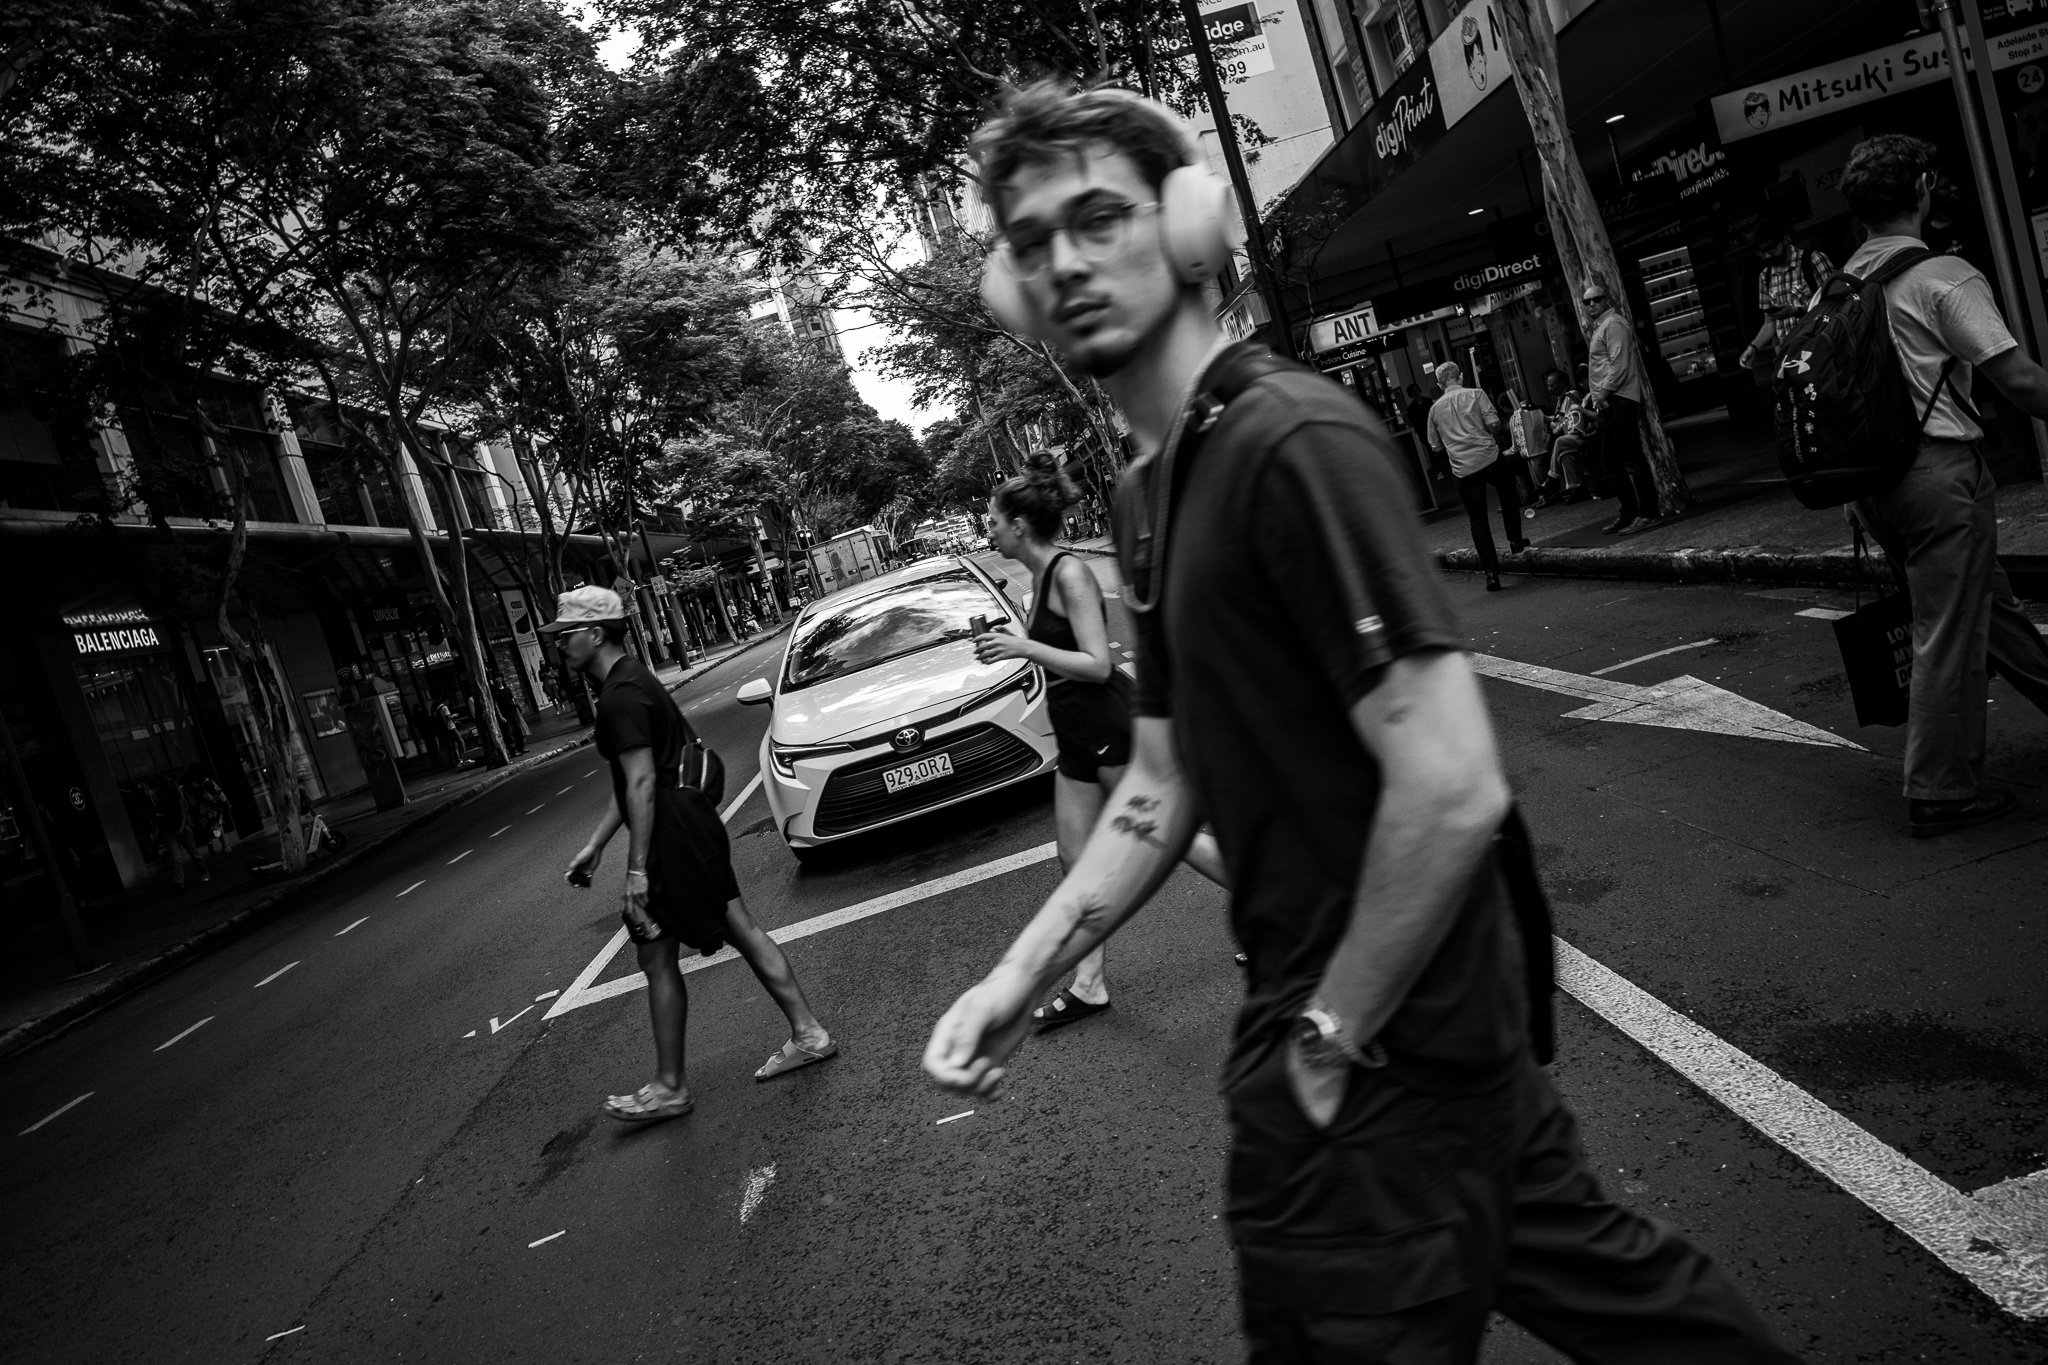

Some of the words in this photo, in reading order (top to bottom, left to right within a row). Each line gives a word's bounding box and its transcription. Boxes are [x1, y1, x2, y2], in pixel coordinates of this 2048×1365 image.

[1997, 32, 2037, 50] Adelaide
[2008, 48, 2030, 60] Stop
[2031, 43, 2043, 53] 24
[1778, 58, 1893, 112] Mitsuki
[1903, 46, 1971, 76] Sus
[2020, 69, 2042, 89] 24
[1375, 76, 1434, 160] digiPrint
[1452, 253, 1542, 292] digiDirect
[1333, 311, 1371, 344] ANT
[1342, 348, 1367, 360] Cuisine
[73, 627, 160, 655] BALENCIAGA
[1885, 621, 1914, 645] LOV
[886, 766, 914, 788] 929
